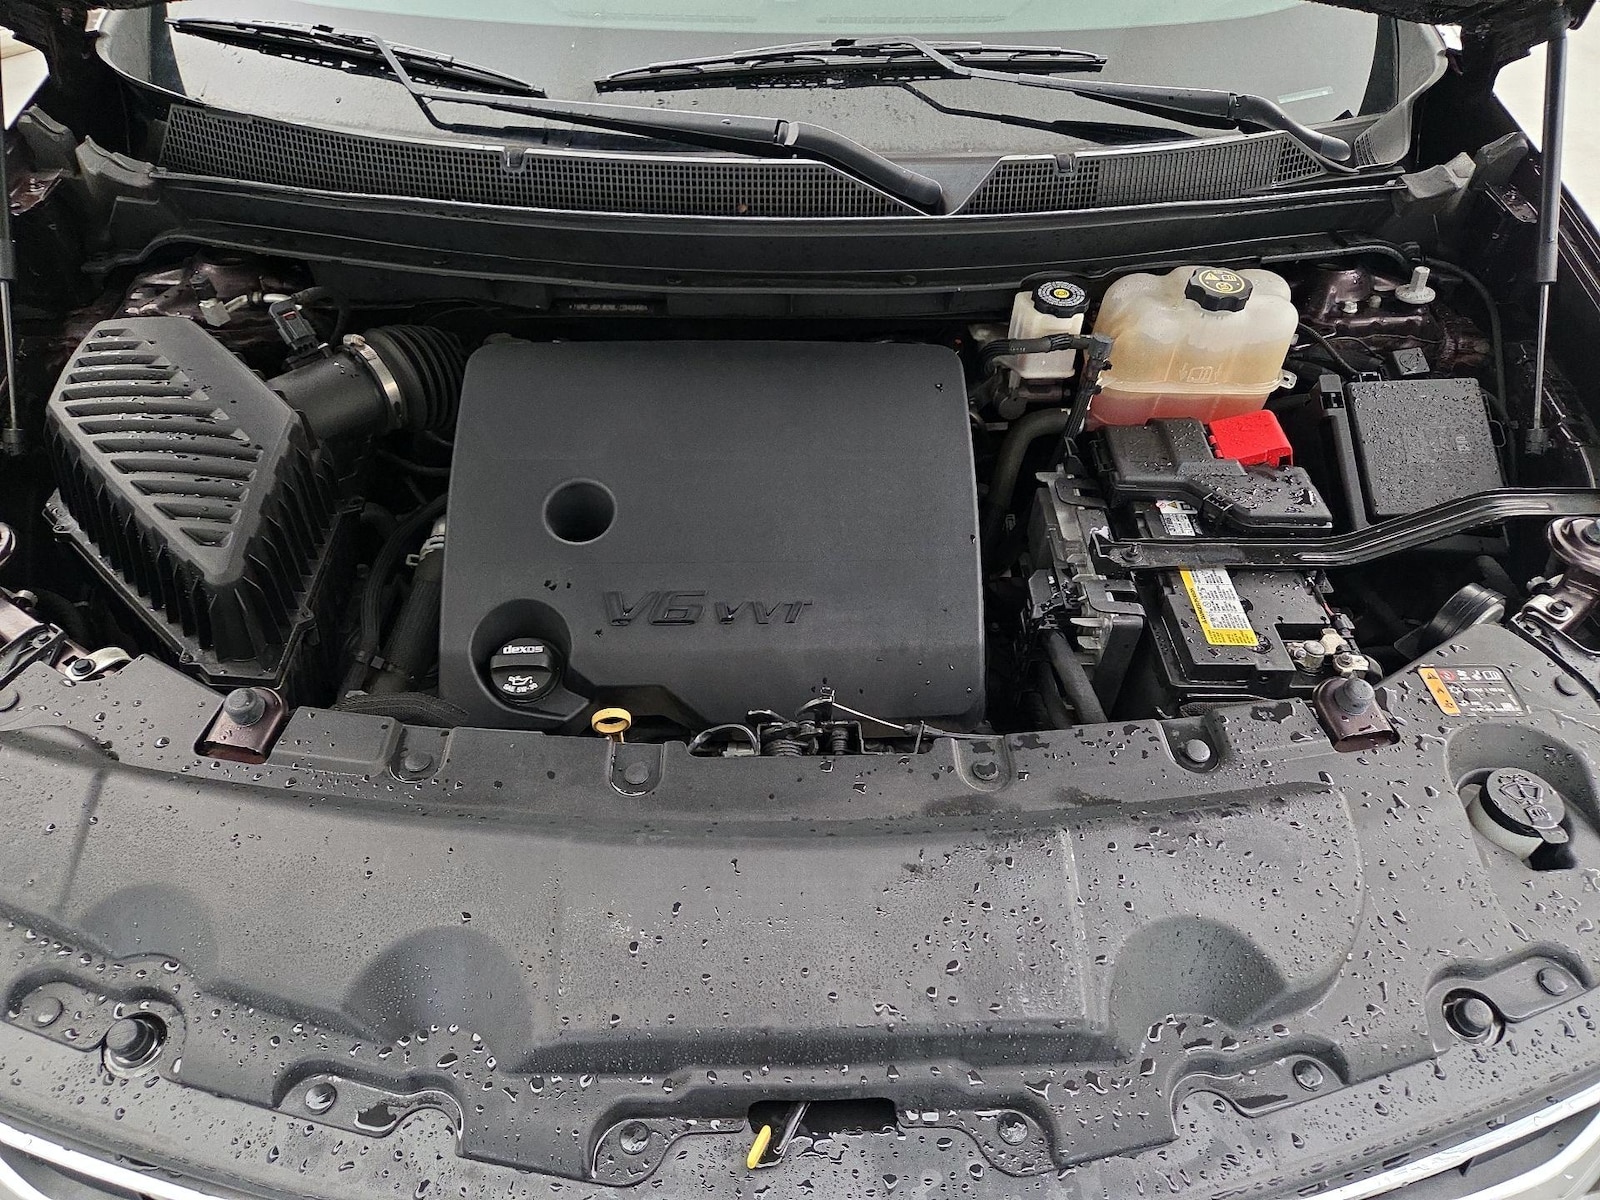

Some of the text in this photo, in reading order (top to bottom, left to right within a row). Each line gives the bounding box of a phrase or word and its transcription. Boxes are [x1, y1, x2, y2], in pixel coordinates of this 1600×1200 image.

[602, 591, 814, 626] V6 VVT
[502, 644, 545, 655] dexos
